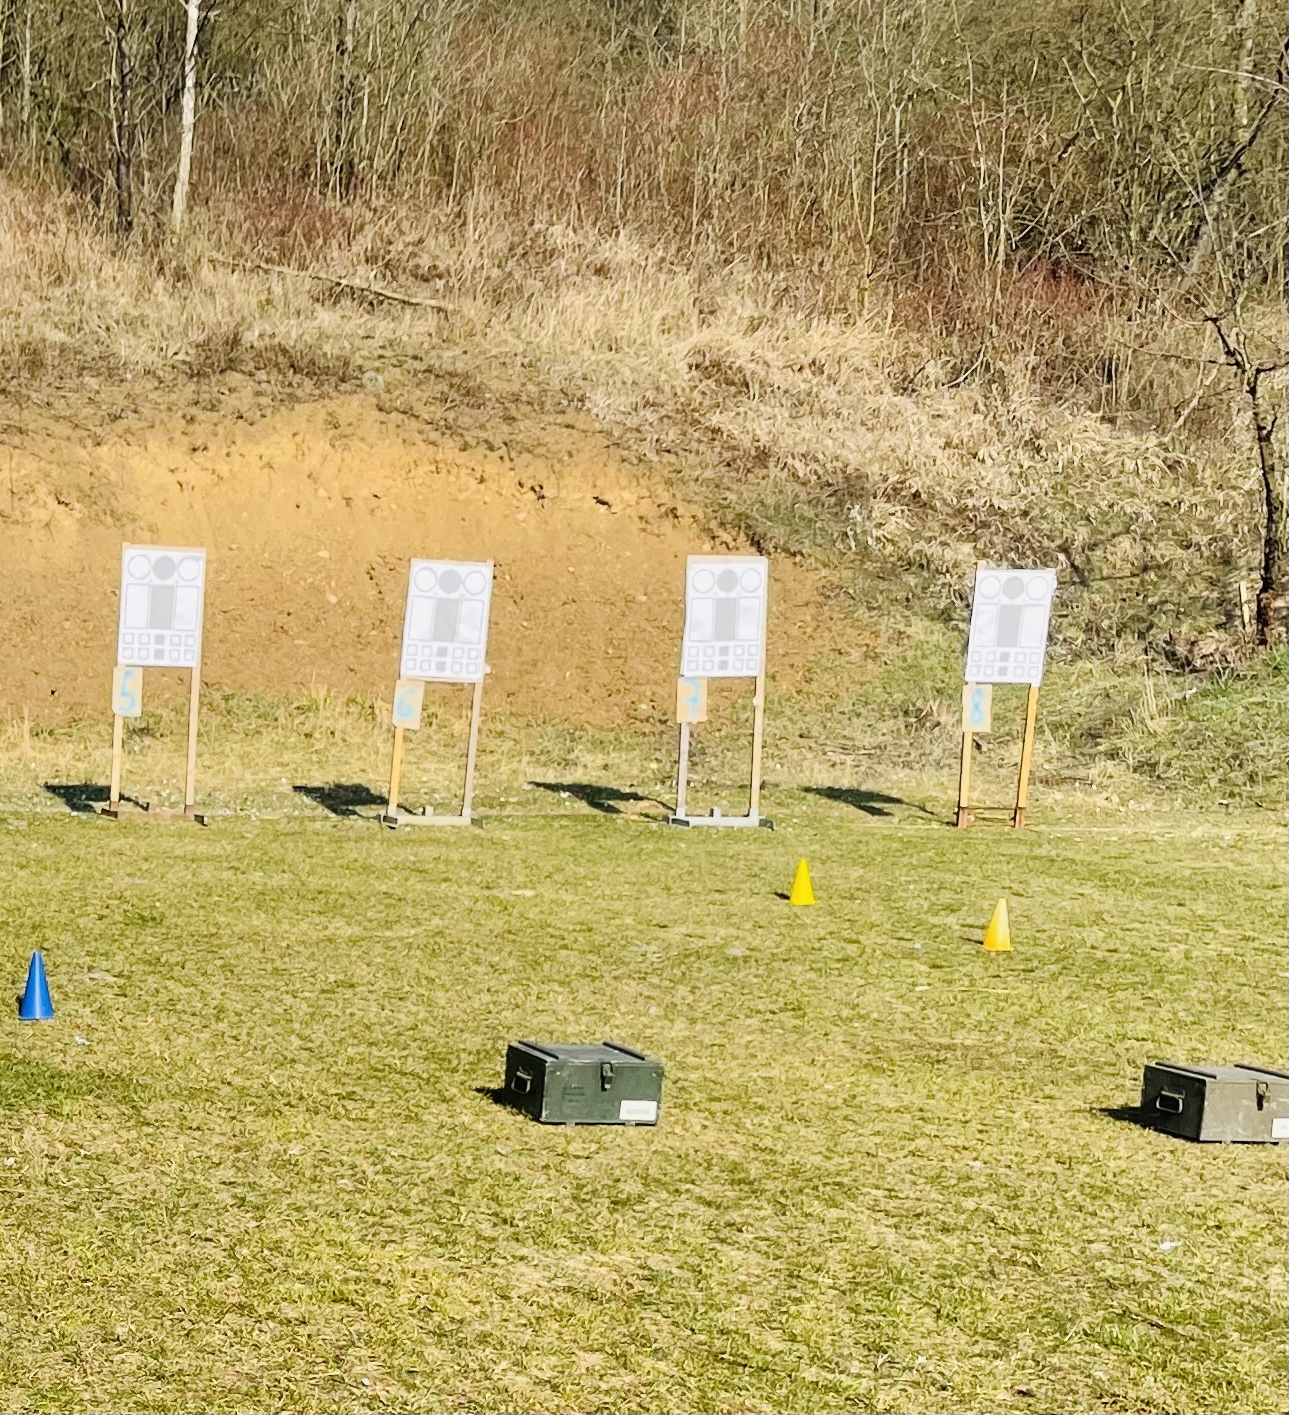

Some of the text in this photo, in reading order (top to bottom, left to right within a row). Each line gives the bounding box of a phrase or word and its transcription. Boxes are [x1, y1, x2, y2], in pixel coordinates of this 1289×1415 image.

[120, 670, 135, 712] 5
[397, 688, 417, 721] 6
[681, 677, 700, 720] 7
[970, 688, 984, 725] 8
